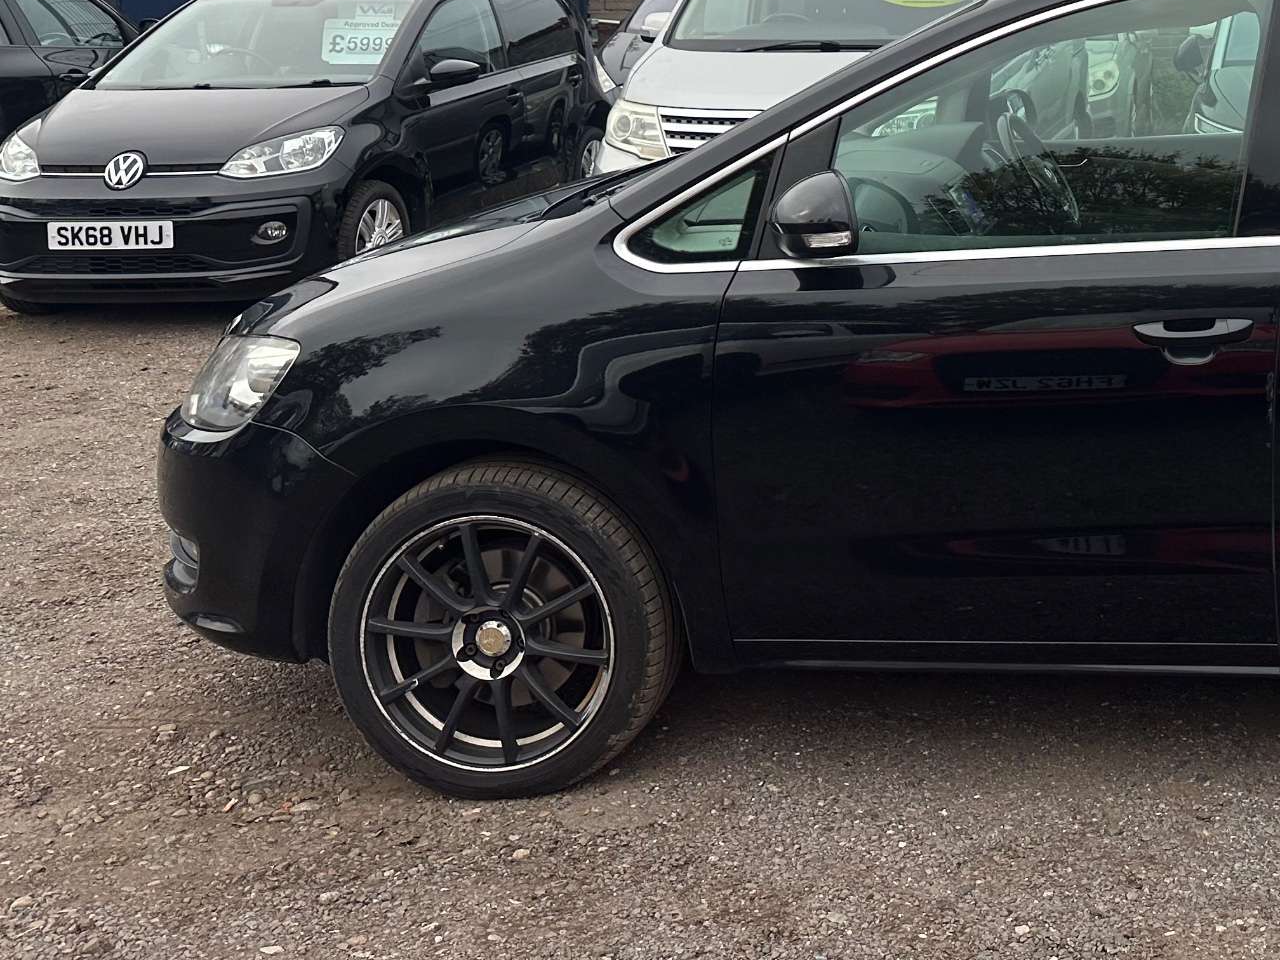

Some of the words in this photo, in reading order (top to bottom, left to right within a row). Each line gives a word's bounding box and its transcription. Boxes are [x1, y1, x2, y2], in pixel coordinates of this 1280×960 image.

[344, 21, 380, 29] Approved
[57, 225, 113, 246] SK68
[120, 225, 163, 245] VHJ
